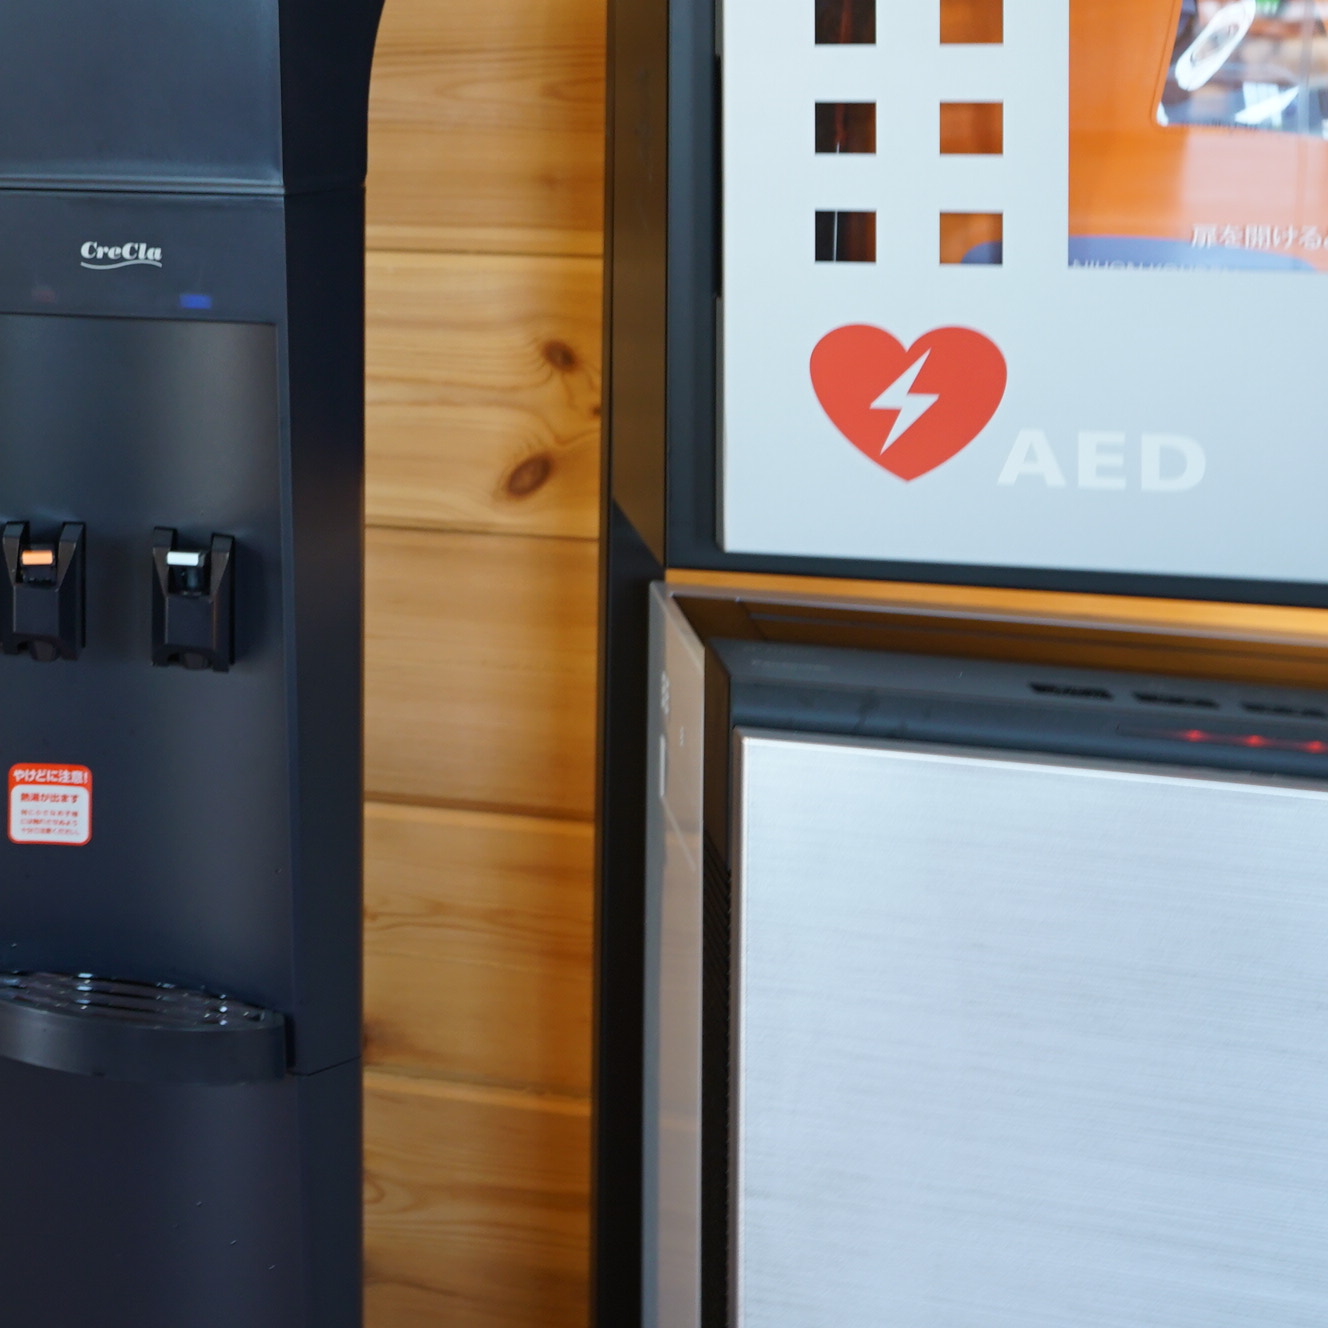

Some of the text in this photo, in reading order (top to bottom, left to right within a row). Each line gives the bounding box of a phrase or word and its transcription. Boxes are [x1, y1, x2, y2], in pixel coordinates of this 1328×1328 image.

[1191, 224, 1328, 250] 扉を開ける
[80, 240, 163, 261] CreCla
[996, 428, 1206, 492] AED
